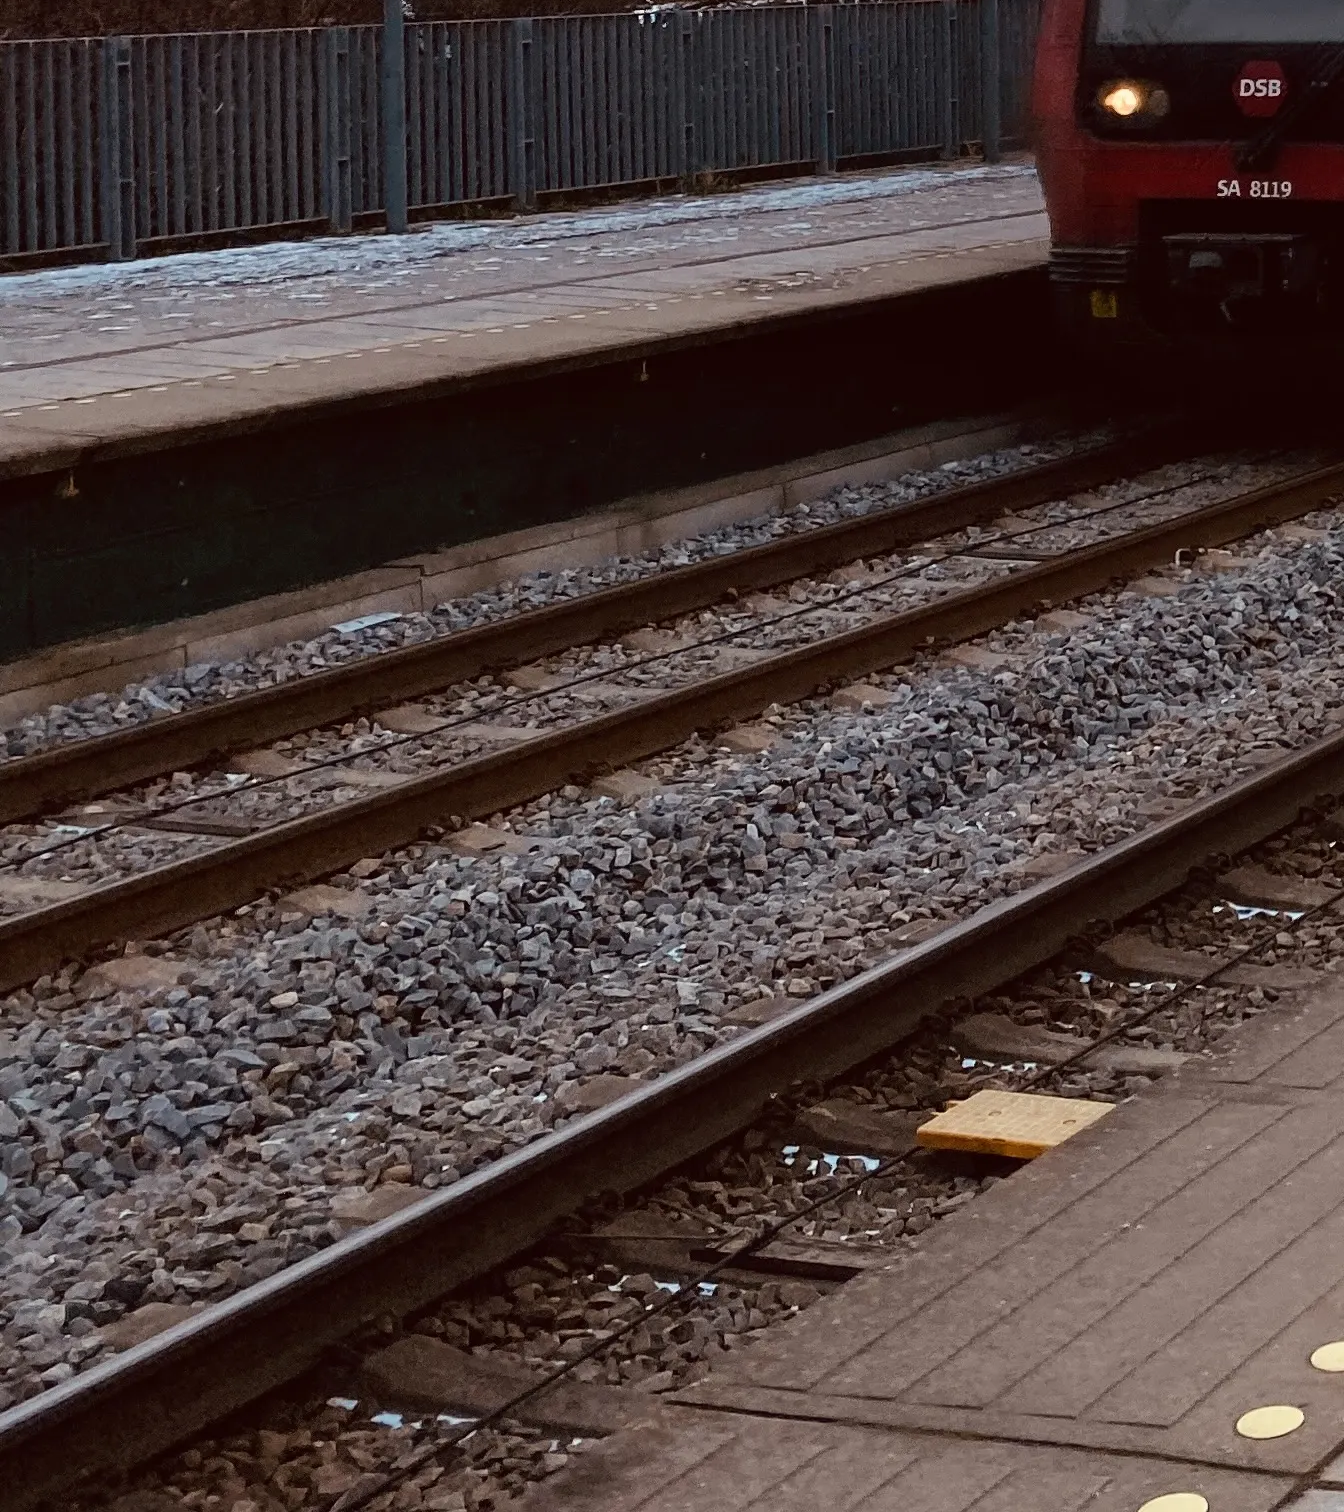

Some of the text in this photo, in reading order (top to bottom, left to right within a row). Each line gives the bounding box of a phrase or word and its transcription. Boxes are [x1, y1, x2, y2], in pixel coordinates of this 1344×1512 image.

[1239, 79, 1281, 97] DSB
[1217, 179, 1292, 198] SA 8119
